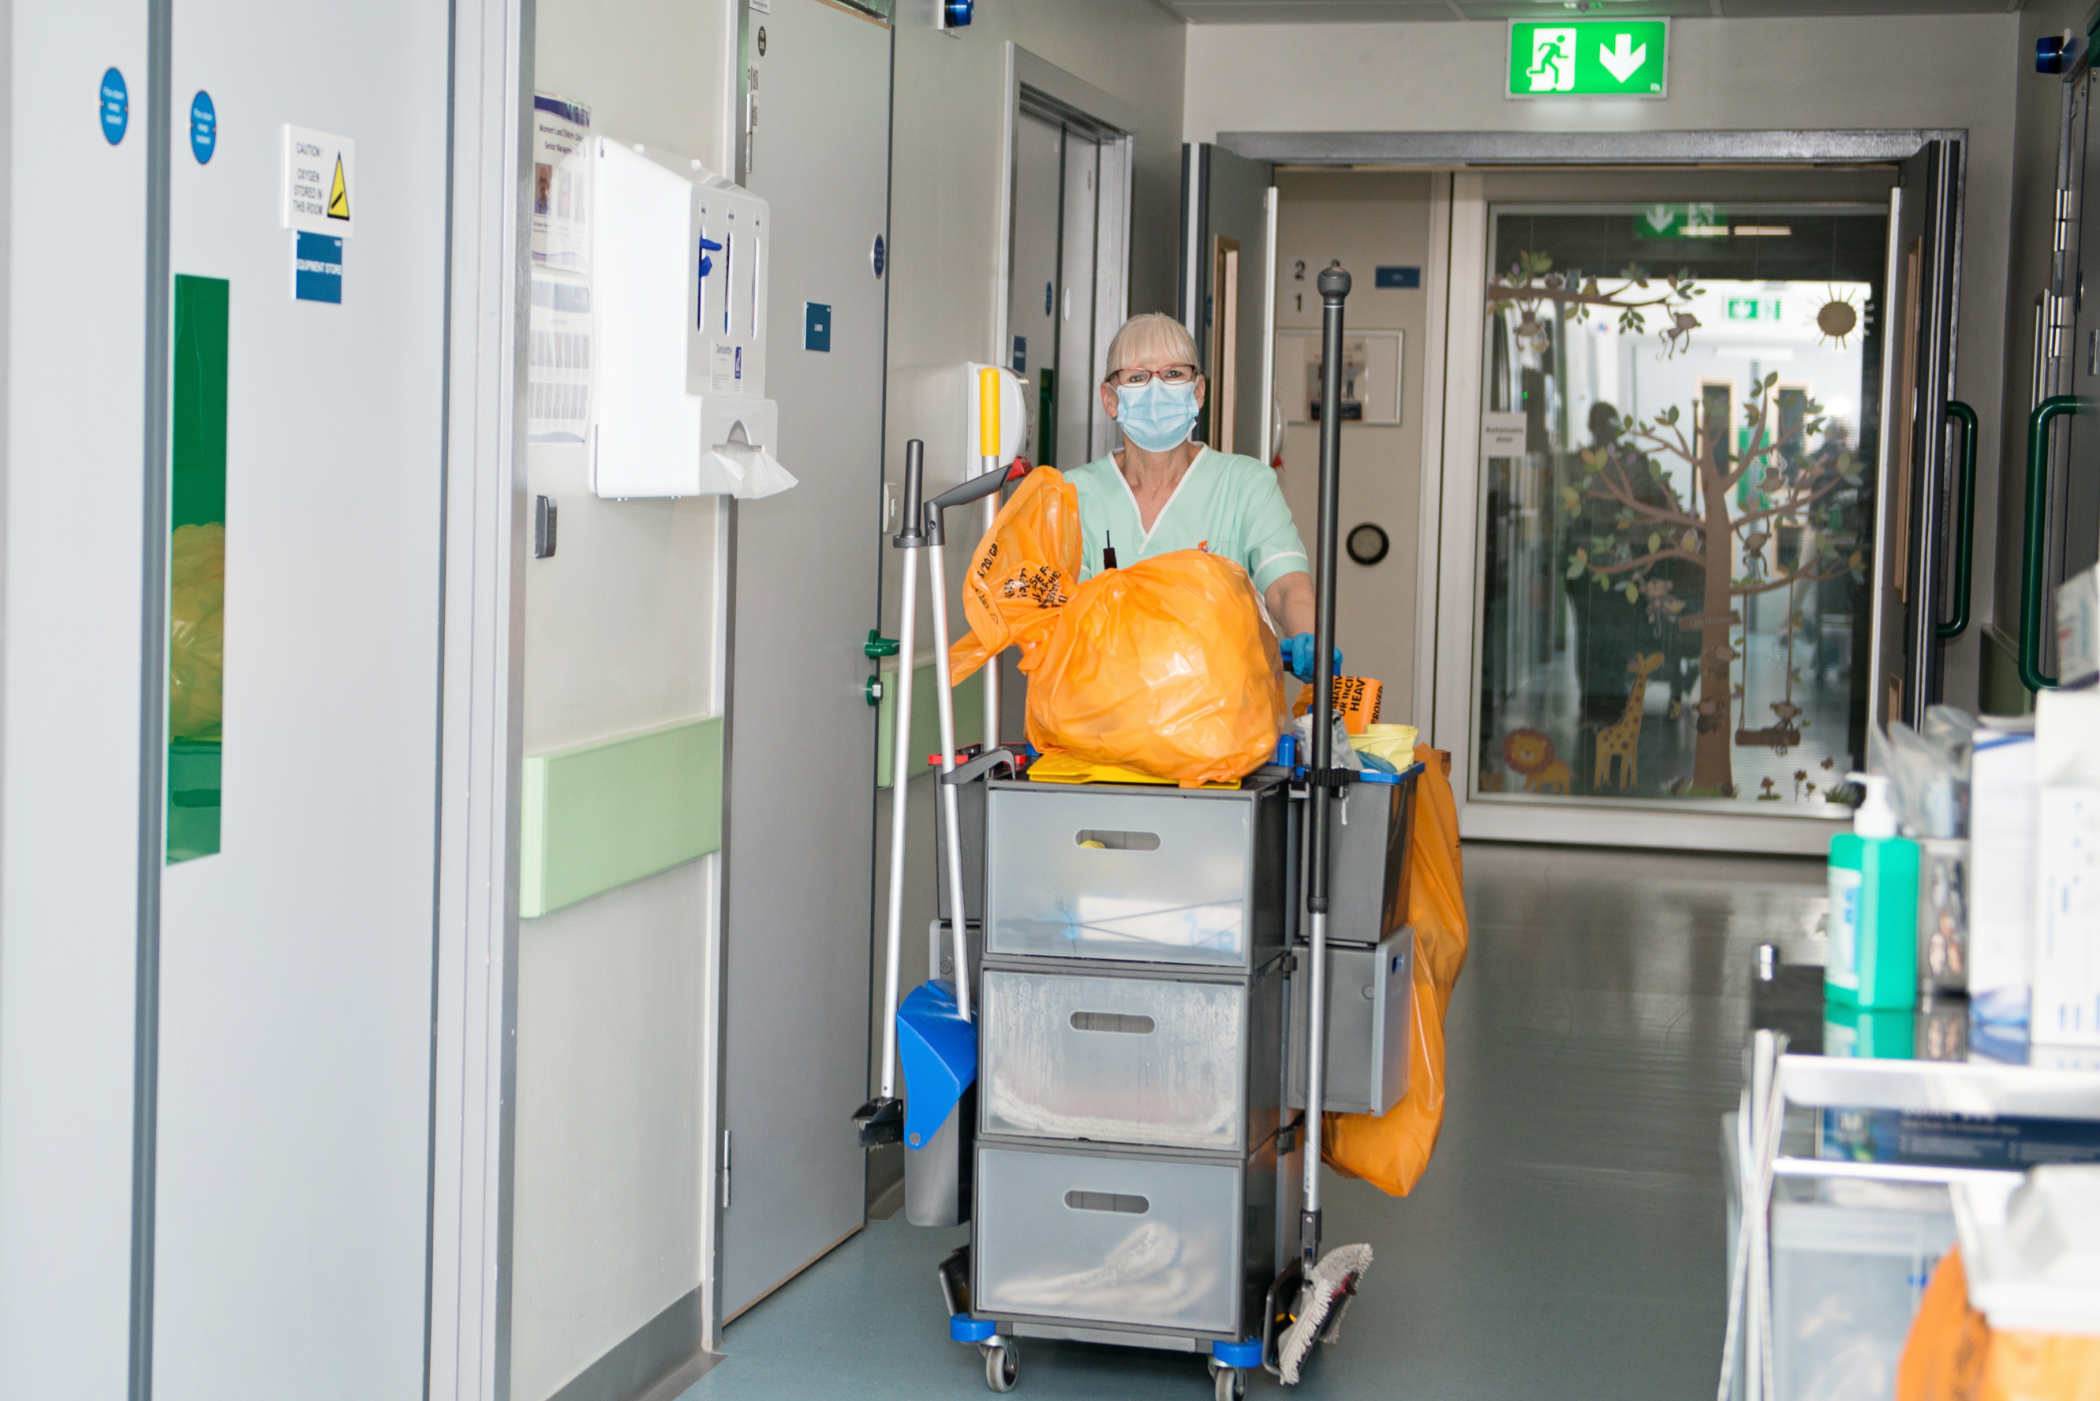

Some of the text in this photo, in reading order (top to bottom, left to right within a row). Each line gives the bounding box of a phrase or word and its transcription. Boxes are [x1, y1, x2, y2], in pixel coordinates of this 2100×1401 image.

[296, 142, 320, 157] CAUTION
[297, 167, 320, 182] OXYGEN
[294, 183, 322, 200] STORED IN
[293, 200, 323, 216] THIS ROOM
[325, 262, 342, 275] STORE
[1294, 260, 1305, 280] 2
[1295, 293, 1302, 312] 1
[1350, 677, 1365, 711] HEAV
